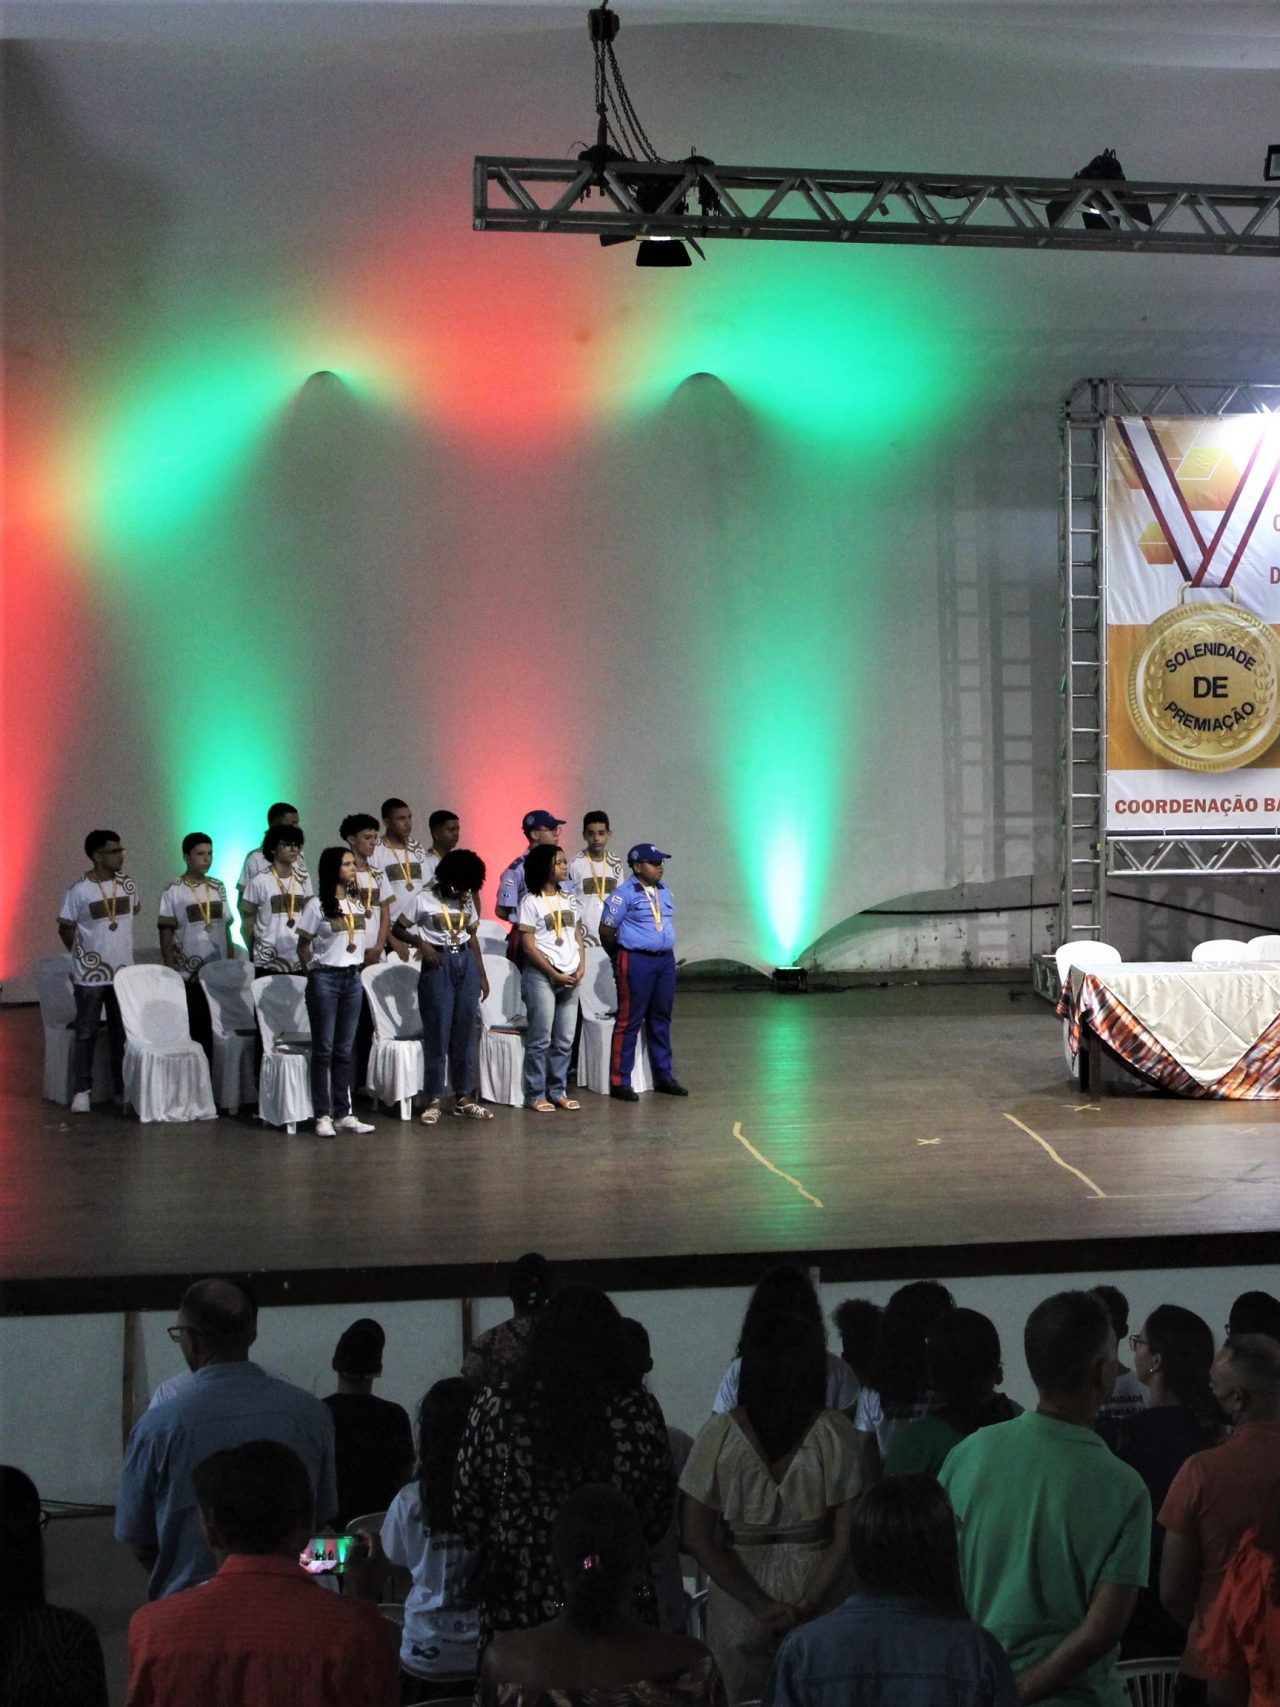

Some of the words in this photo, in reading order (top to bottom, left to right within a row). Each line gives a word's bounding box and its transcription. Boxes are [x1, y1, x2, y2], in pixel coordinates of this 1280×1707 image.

[1165, 642, 1257, 673] SOLENIDADE
[1193, 676, 1229, 699] DE
[1164, 701, 1255, 732] PREMIAÇÃO
[1114, 794, 1259, 817] COORDENAÇÃO
